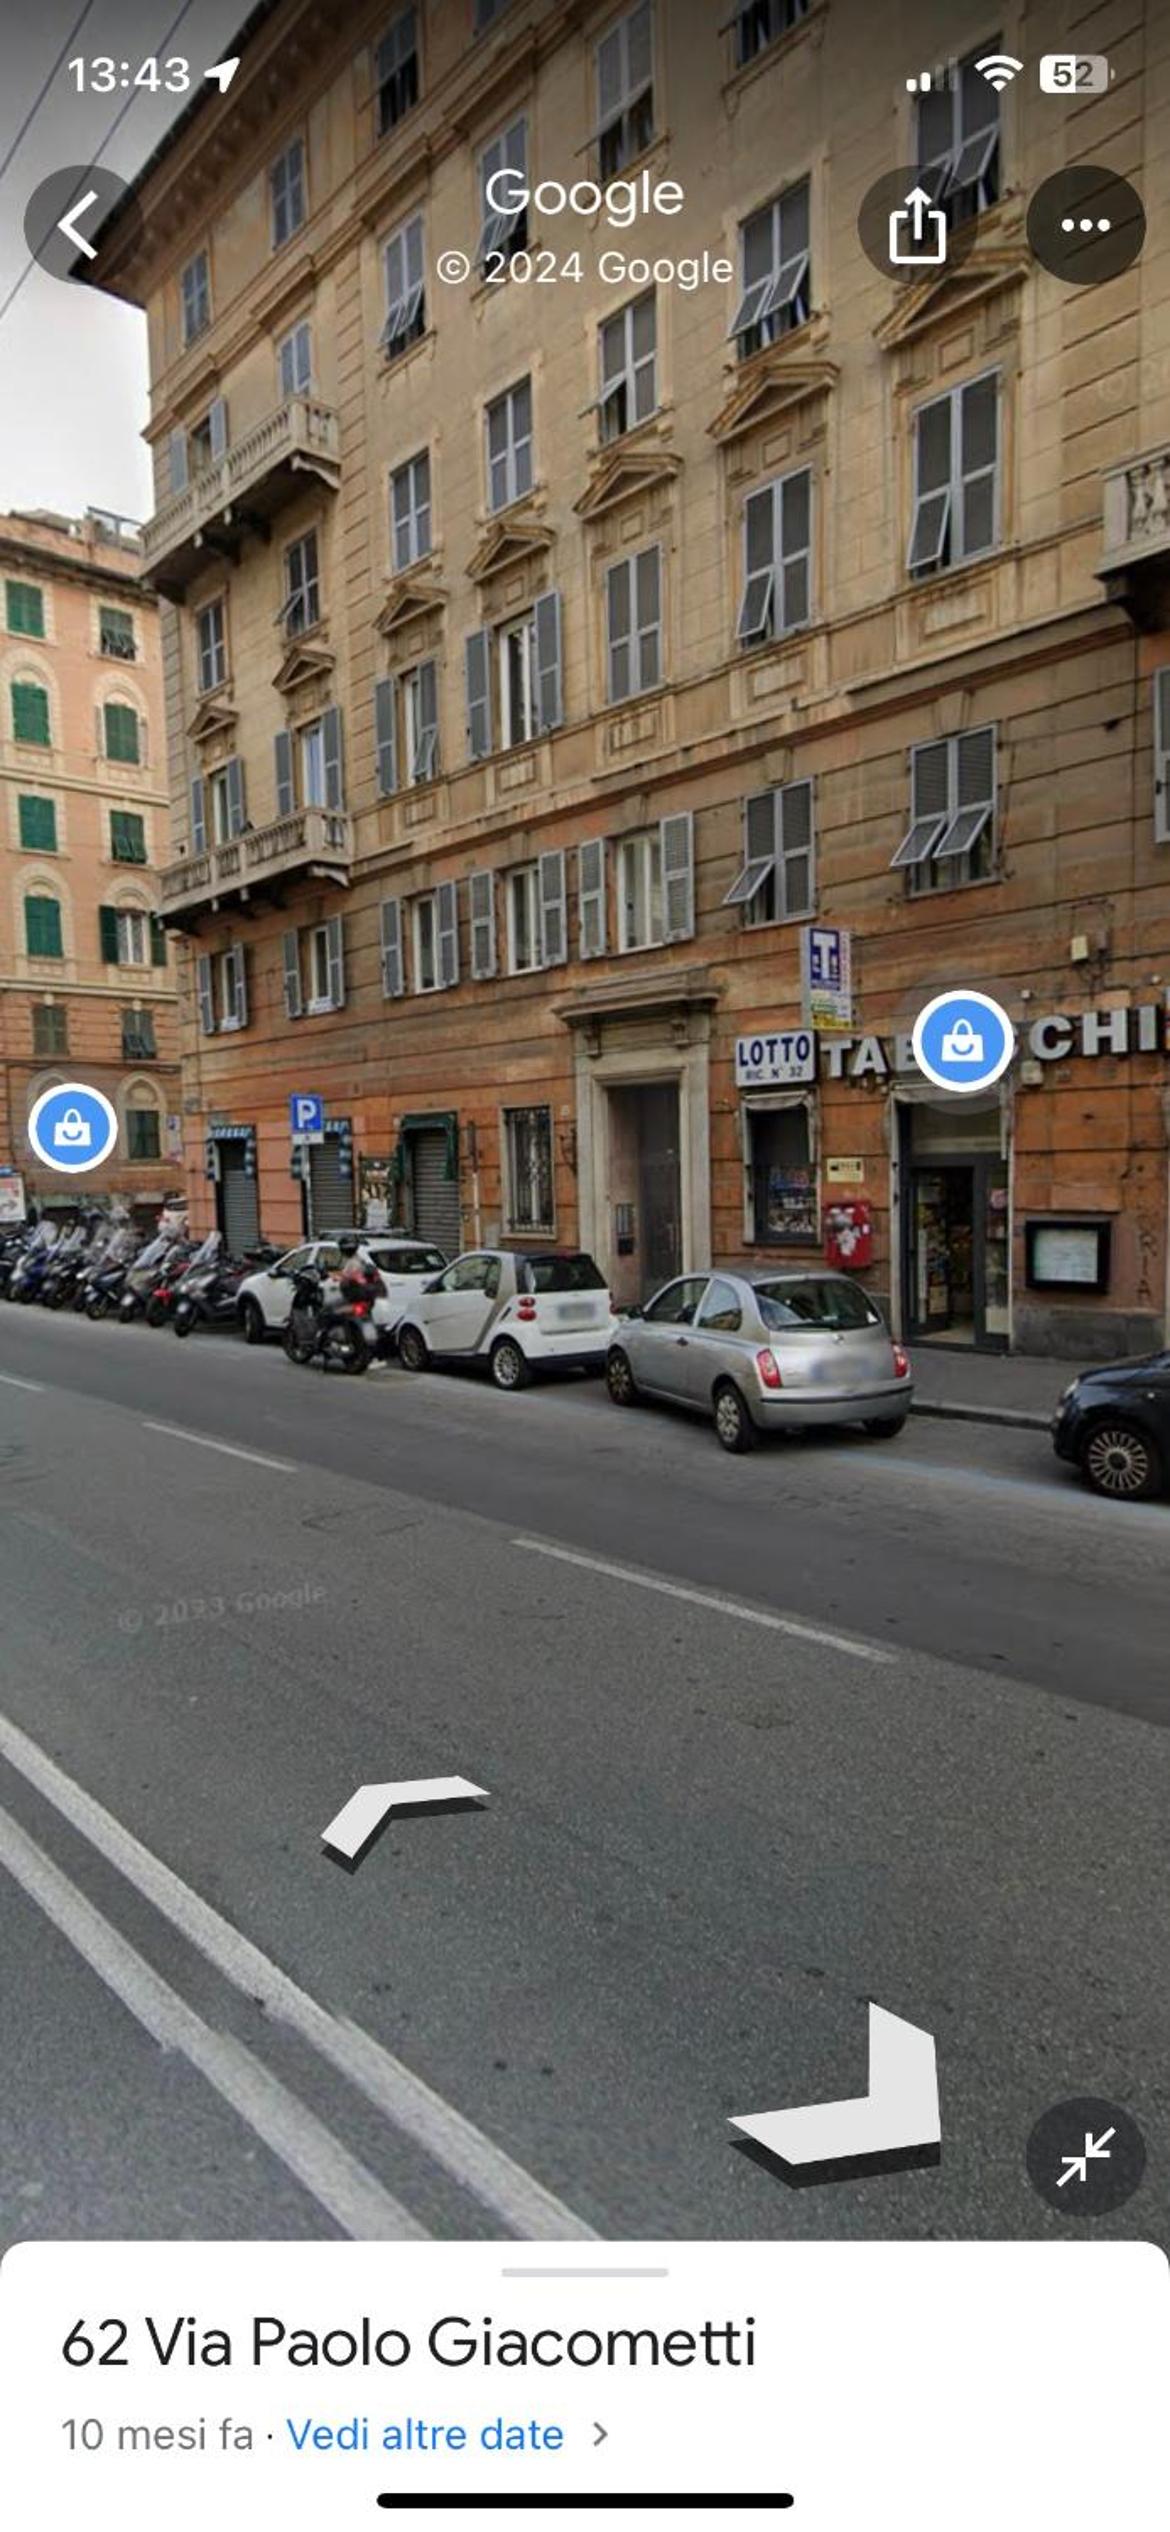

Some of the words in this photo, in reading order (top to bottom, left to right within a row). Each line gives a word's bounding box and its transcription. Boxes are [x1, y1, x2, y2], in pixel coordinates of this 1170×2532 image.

[738, 1035, 810, 1067] LOTTO
[819, 1006, 1158, 1078] TABCHI
[297, 1100, 317, 1128] P
